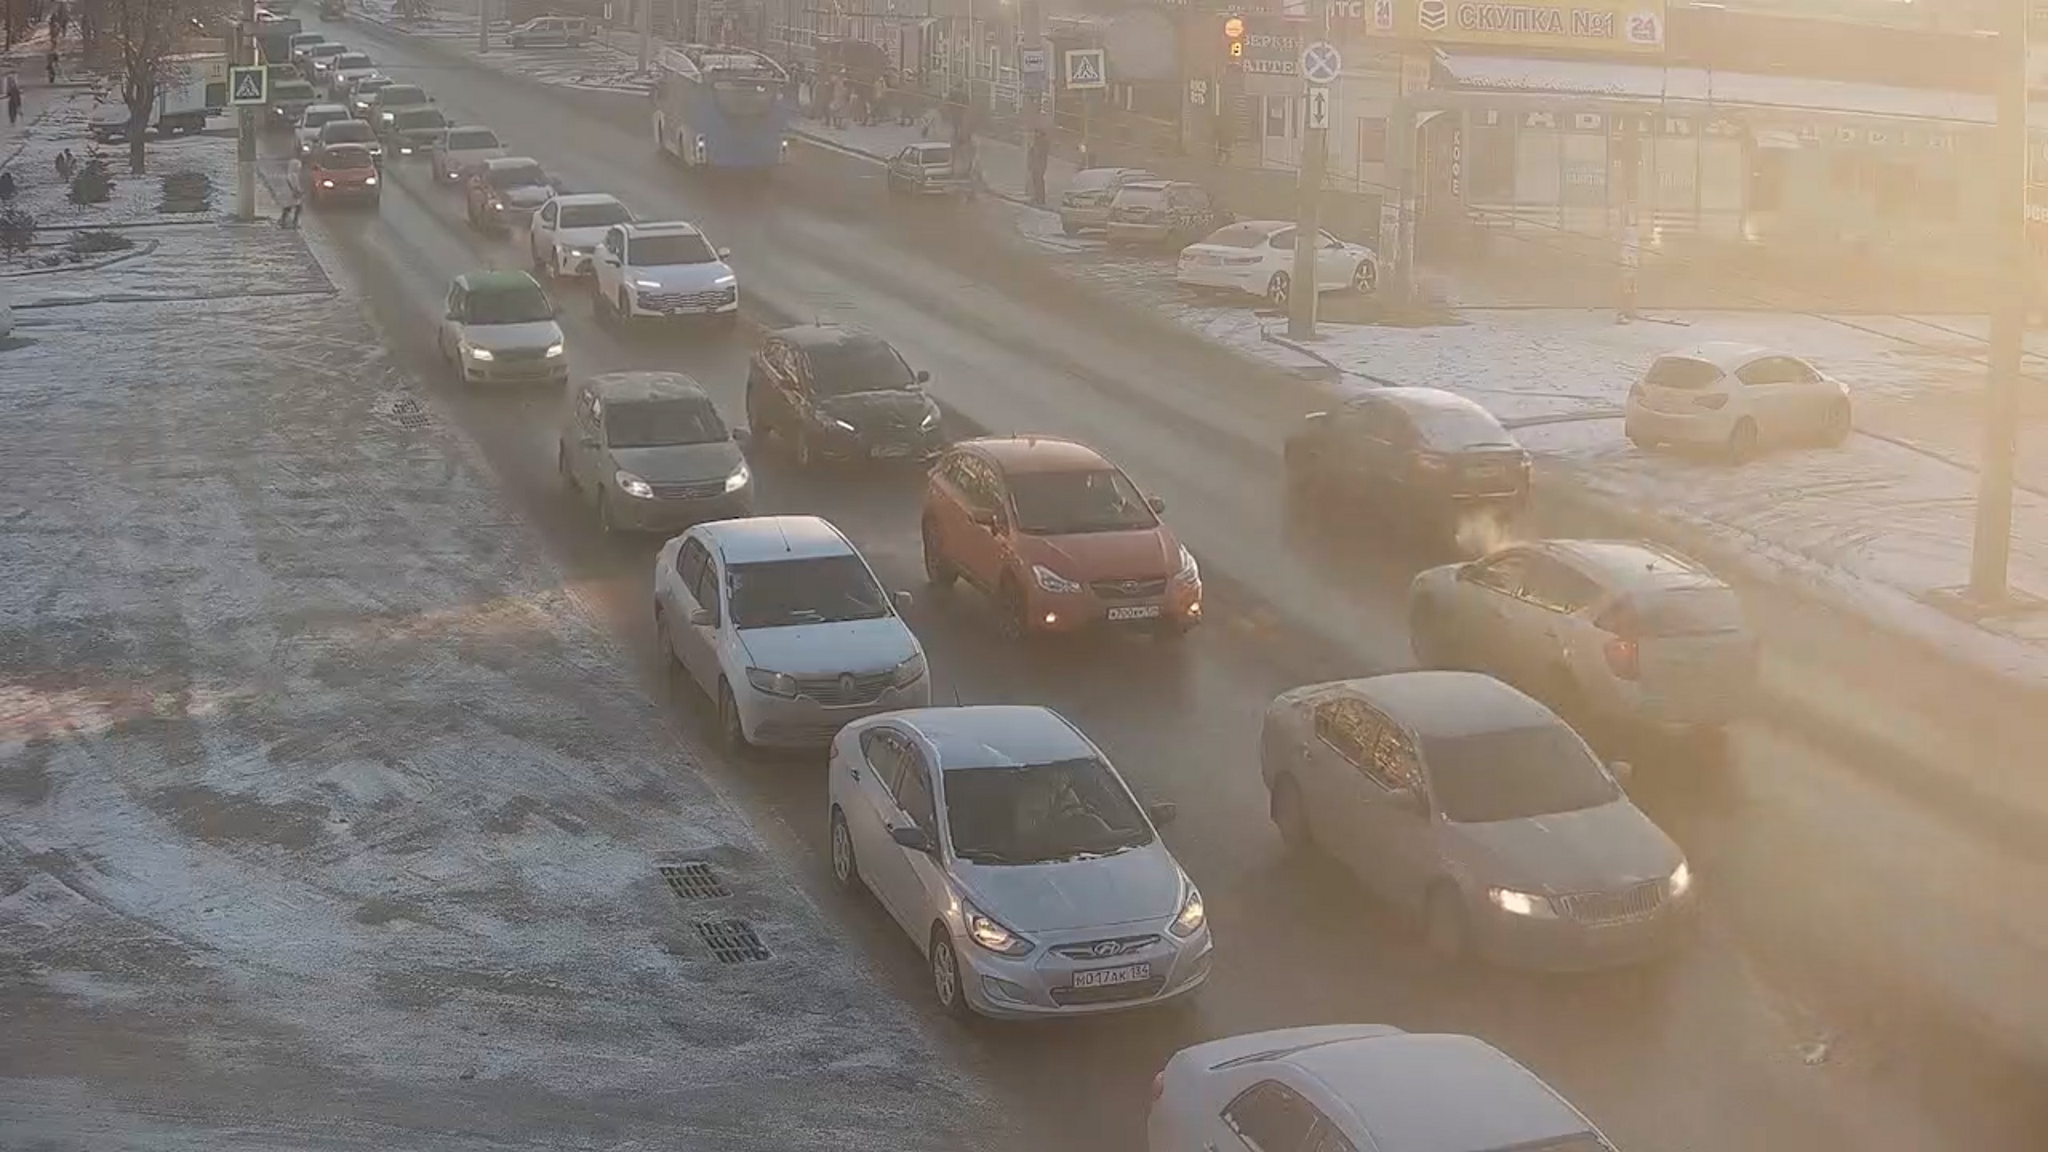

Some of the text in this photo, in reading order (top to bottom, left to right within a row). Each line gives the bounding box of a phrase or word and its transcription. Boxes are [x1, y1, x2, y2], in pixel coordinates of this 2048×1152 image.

[1457, 4, 1614, 37] СКУПКА №1
[1631, 17, 1655, 31] 24
